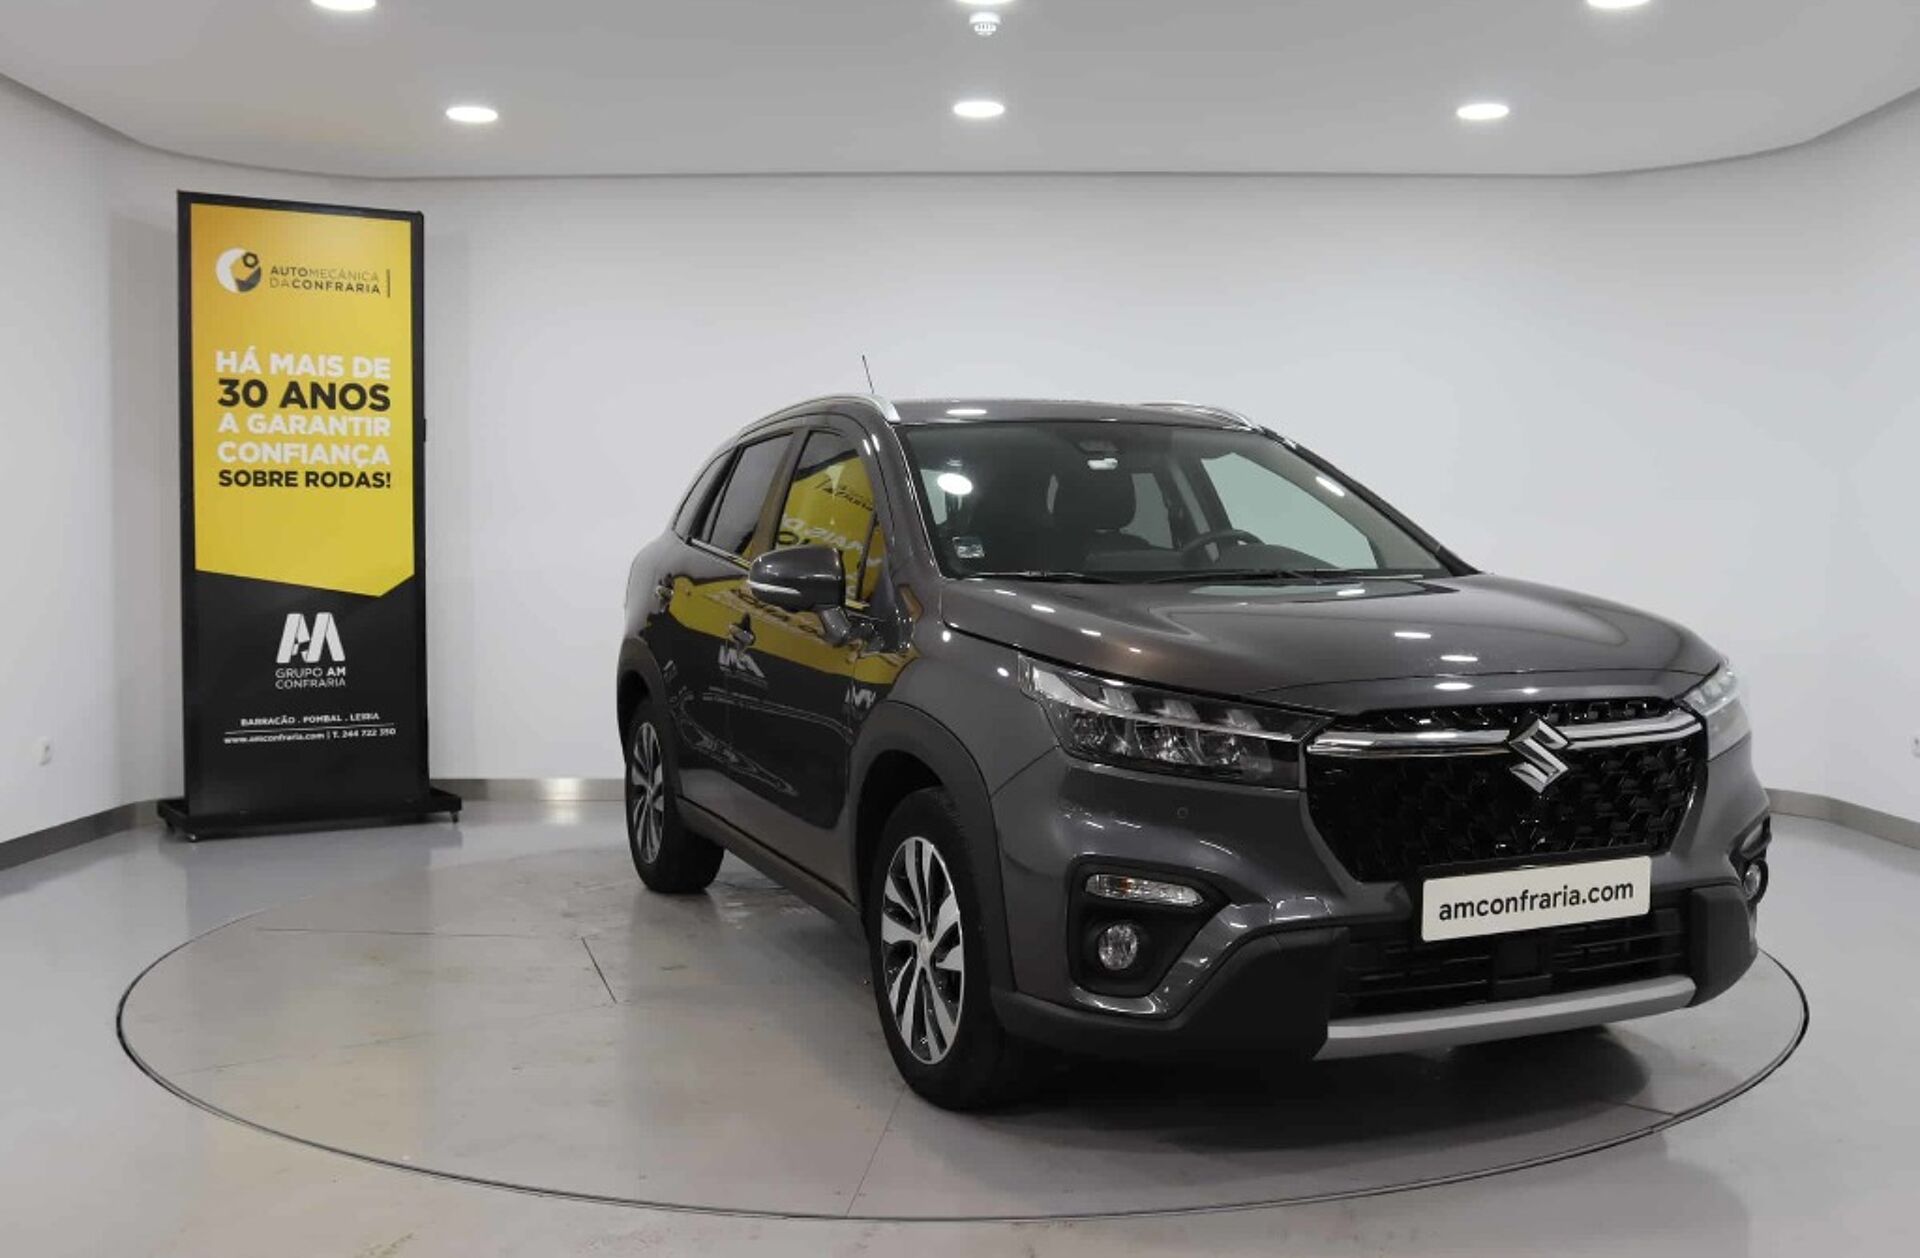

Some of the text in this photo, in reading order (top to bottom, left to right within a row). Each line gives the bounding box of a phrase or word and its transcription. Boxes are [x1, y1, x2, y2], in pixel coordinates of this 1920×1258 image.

[269, 277, 381, 294] DACONFRARIA
[215, 345, 391, 380] HÁ MAIS DE
[217, 378, 391, 412] 30 ANOS
[217, 412, 391, 437] A GARANTIR
[217, 440, 391, 468] CONFIANÇA
[218, 469, 391, 489] SOBRE RODAS!
[275, 666, 346, 678] GRUPO AM
[275, 677, 346, 690] CONFRARIA
[303, 714, 342, 724] POMBAL
[224, 732, 325, 744] www.amconfraria.com
[1438, 880, 1634, 922] amconfraria.com
